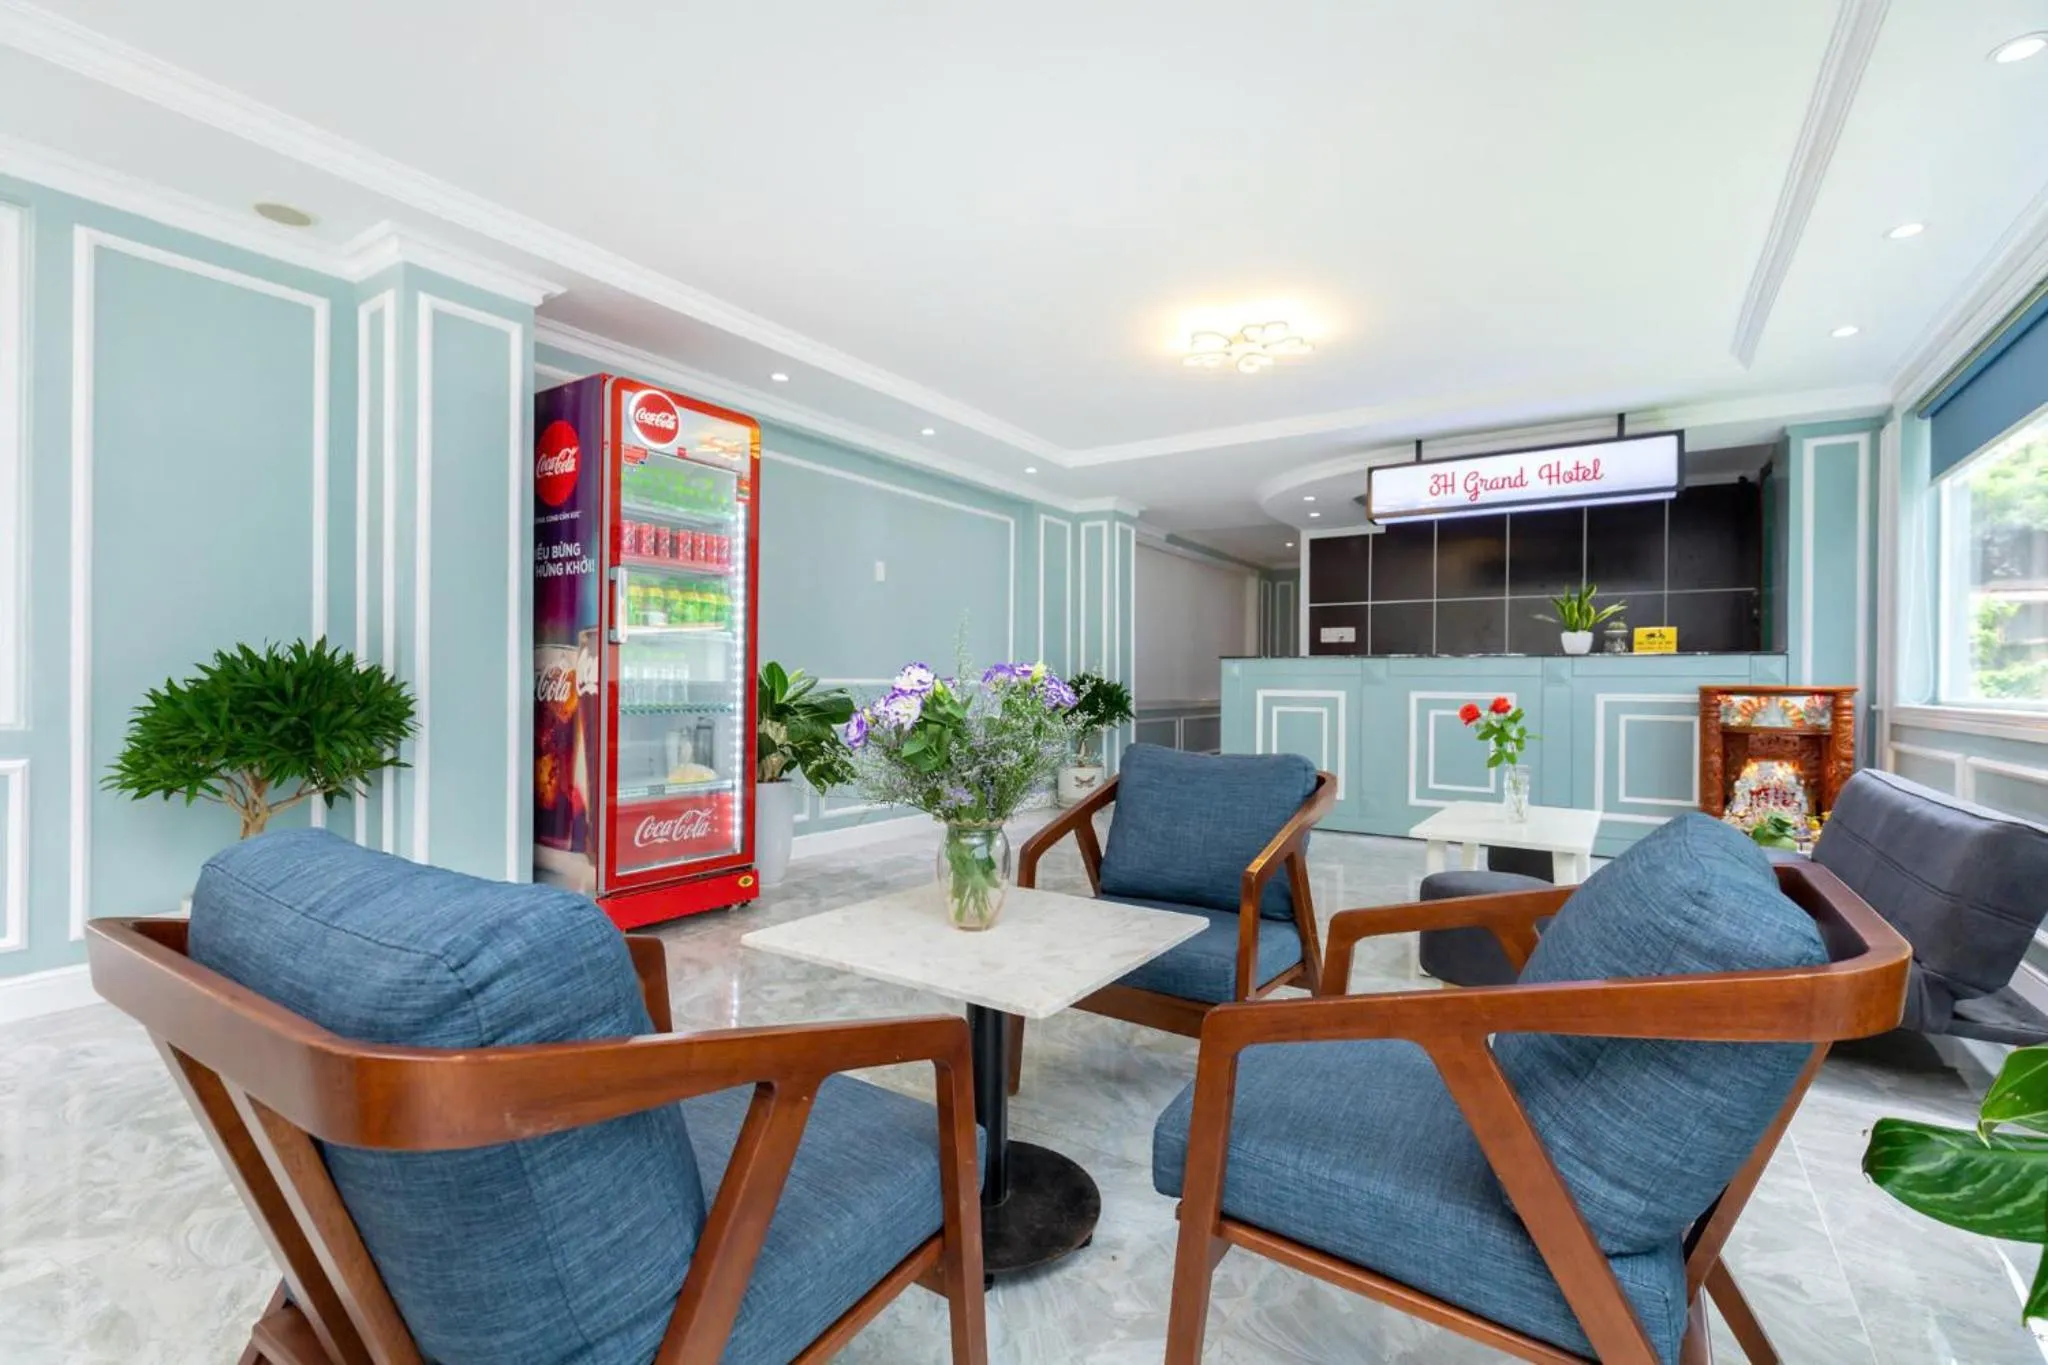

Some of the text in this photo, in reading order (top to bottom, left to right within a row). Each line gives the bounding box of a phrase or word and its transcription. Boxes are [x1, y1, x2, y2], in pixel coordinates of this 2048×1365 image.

[635, 408, 676, 430] Coca-Cola
[536, 447, 578, 478] Coca-Cola
[1429, 458, 1604, 502] 3H Grand Hotel
[634, 808, 712, 848] Coca-Cola
